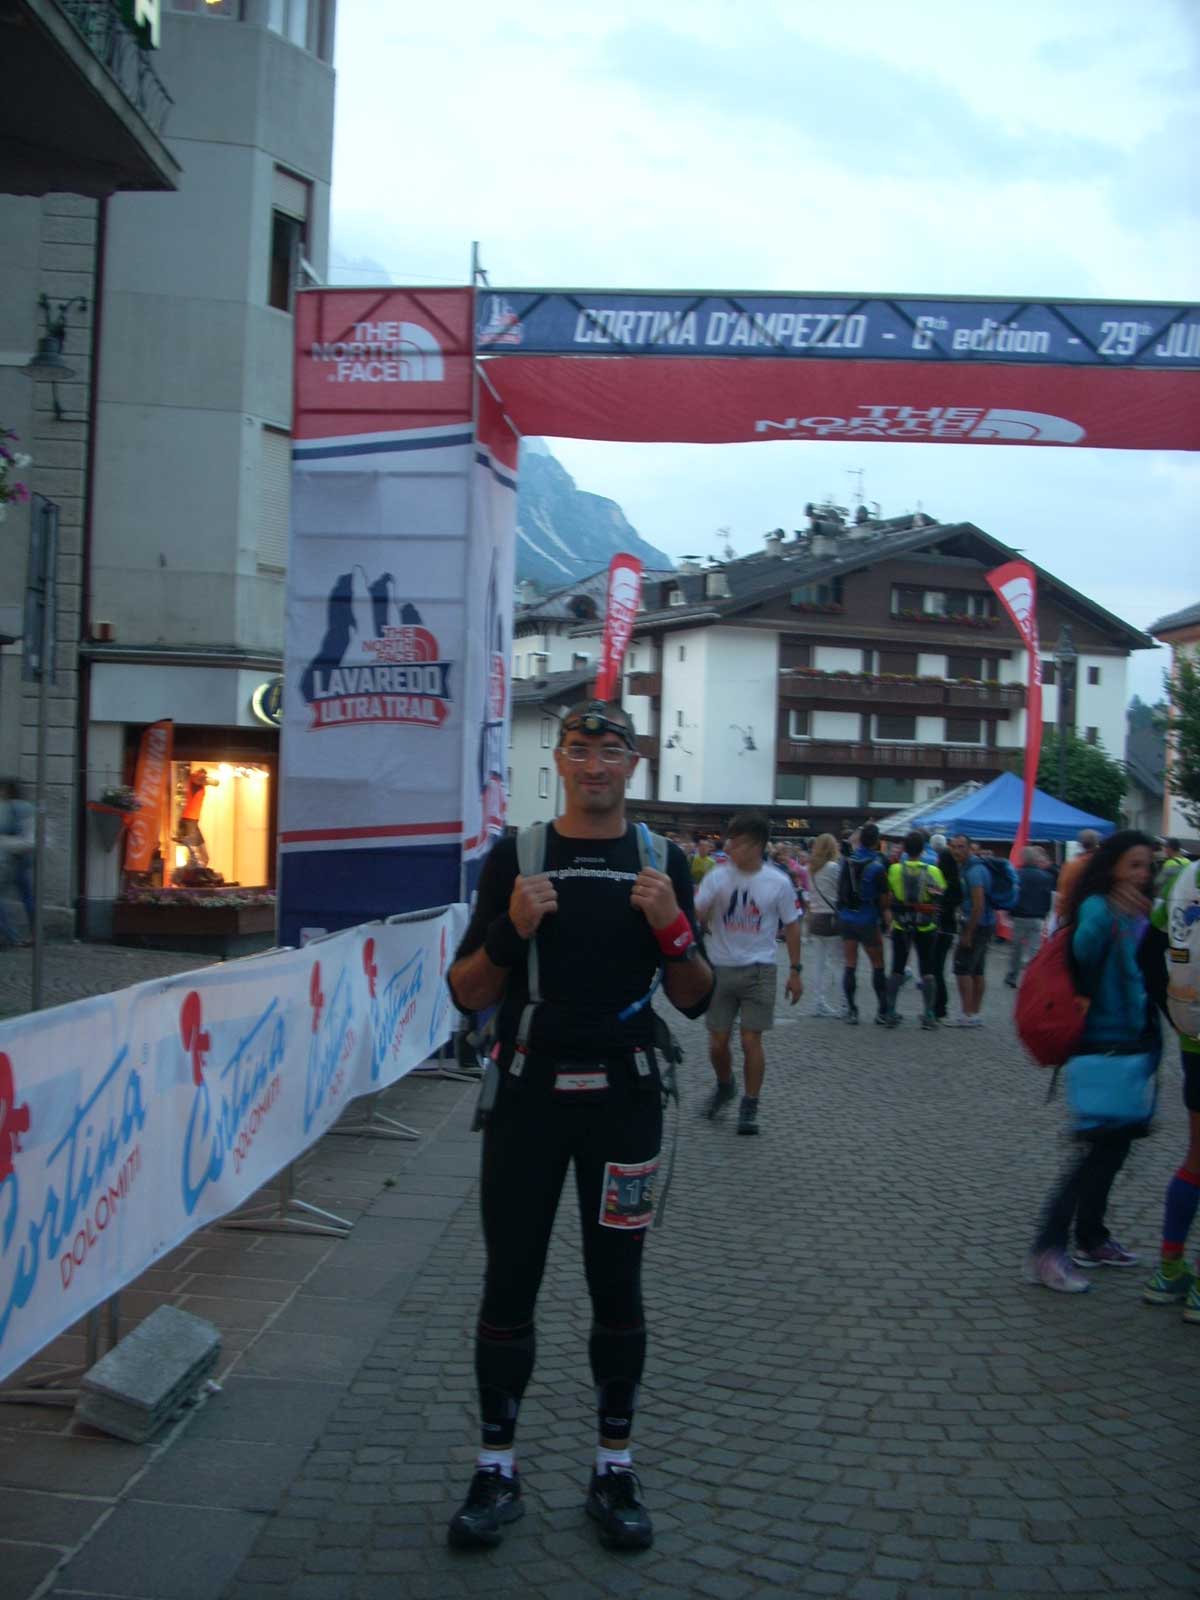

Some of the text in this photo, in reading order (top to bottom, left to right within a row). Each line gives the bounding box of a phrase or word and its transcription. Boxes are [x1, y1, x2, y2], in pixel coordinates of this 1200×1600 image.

[352, 322, 398, 341] THE
[574, 308, 697, 346] CORTINA
[705, 311, 868, 349] D'AMPEZZO
[951, 318, 1050, 354] edition
[311, 341, 398, 362] NORTH
[336, 362, 399, 382] FACE
[856, 405, 985, 419] THE
[754, 416, 977, 433] NORTH
[815, 425, 971, 438] FACE
[312, 665, 443, 699] LAVAREDO
[181, 996, 285, 1217] Cortina
[60, 1142, 142, 1291] DOLOMITI
